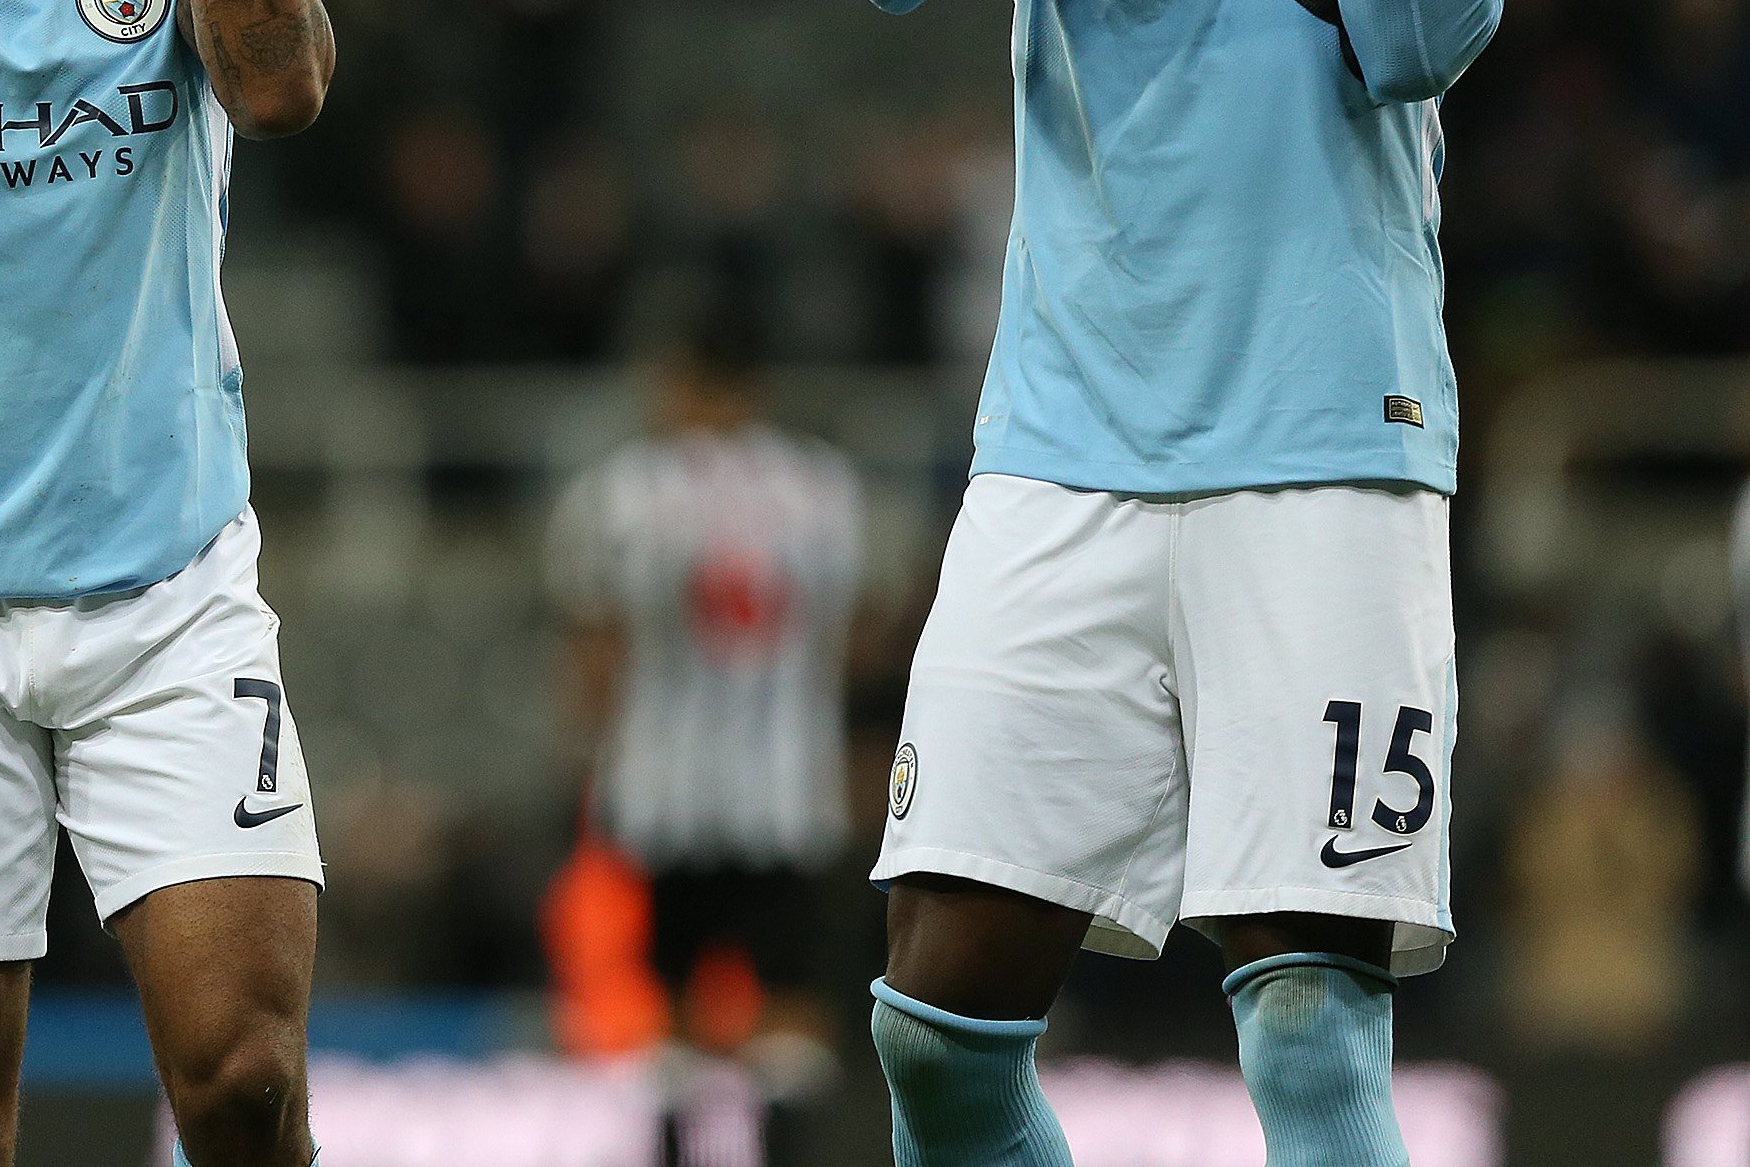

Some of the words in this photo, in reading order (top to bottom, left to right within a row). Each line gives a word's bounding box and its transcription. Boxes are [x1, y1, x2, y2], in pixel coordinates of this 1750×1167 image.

[120, 22, 146, 37] CITY
[233, 677, 282, 793] 7
[1322, 699, 1435, 835] 15
